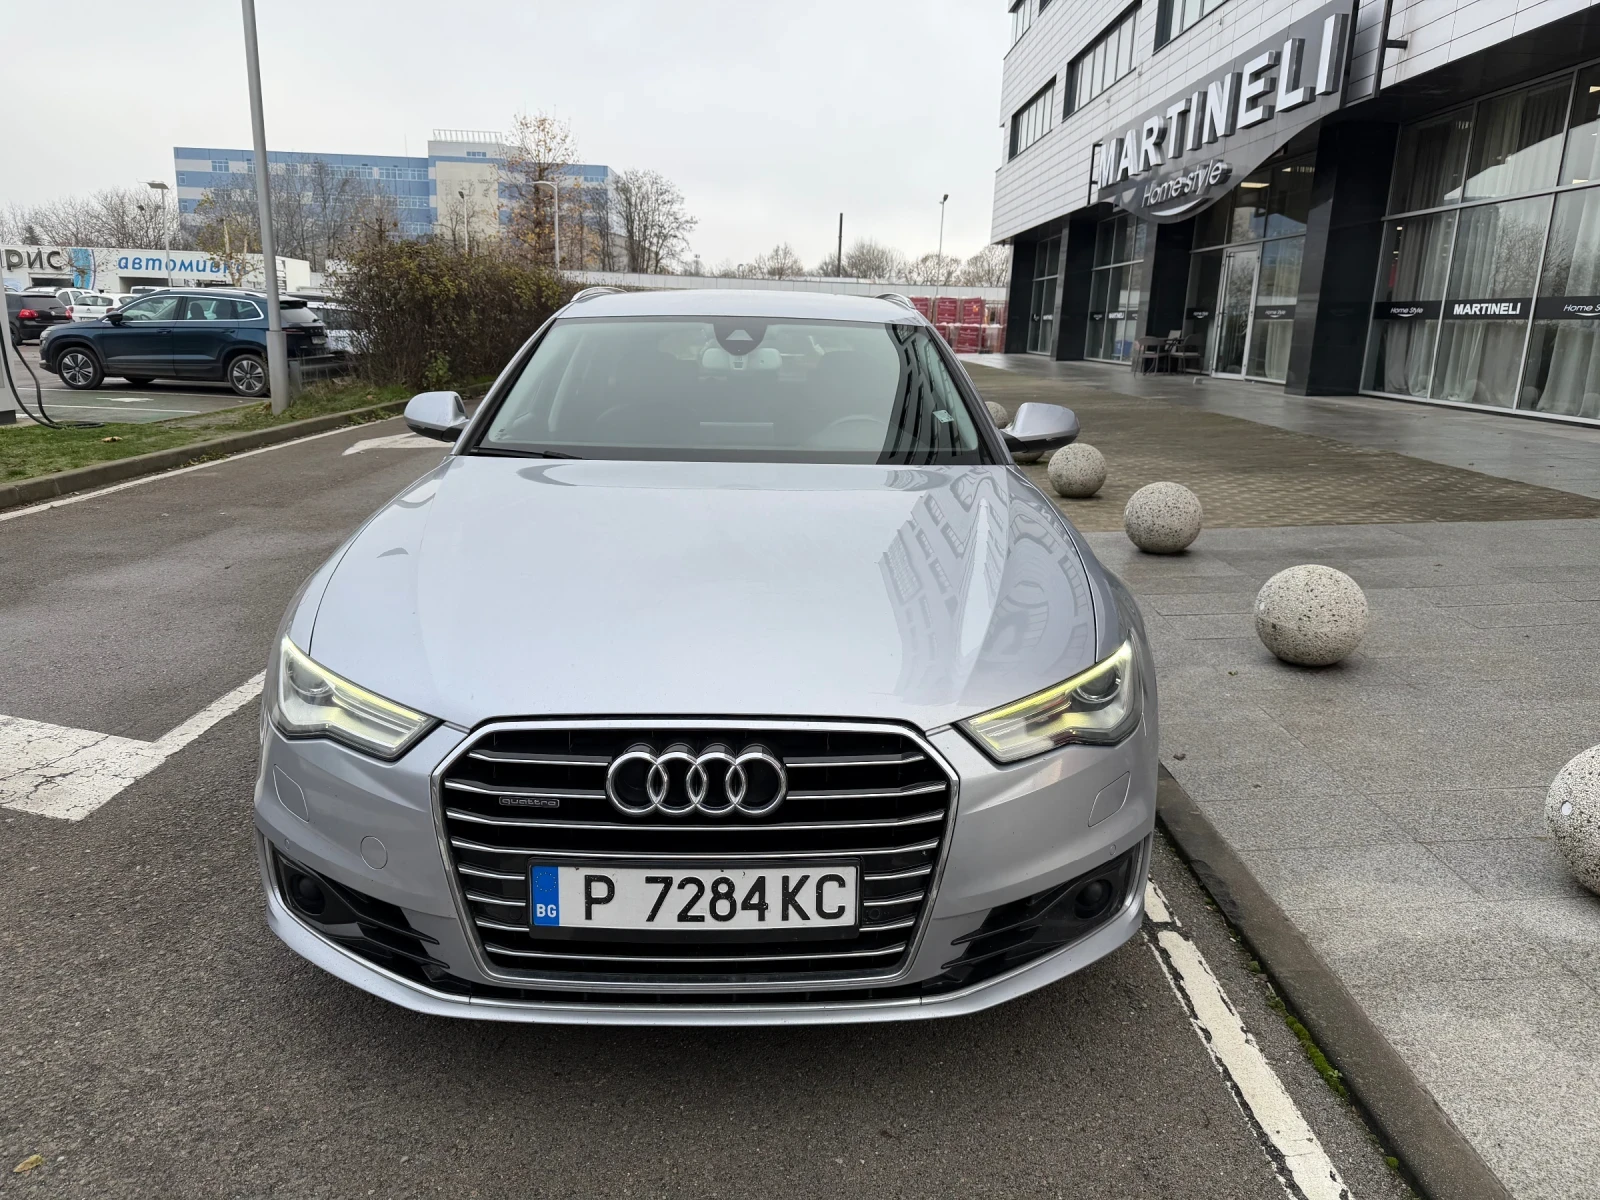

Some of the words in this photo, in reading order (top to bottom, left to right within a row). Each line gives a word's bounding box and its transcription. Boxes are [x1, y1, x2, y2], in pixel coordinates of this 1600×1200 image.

[1097, 13, 1349, 190] MARTINELI
[1141, 176, 1184, 209] Home
[1453, 302, 1522, 316] MARTINELI
[1563, 304, 1594, 312] Home
[502, 797, 557, 807] quattro
[584, 874, 615, 920] P
[536, 903, 557, 918] BG
